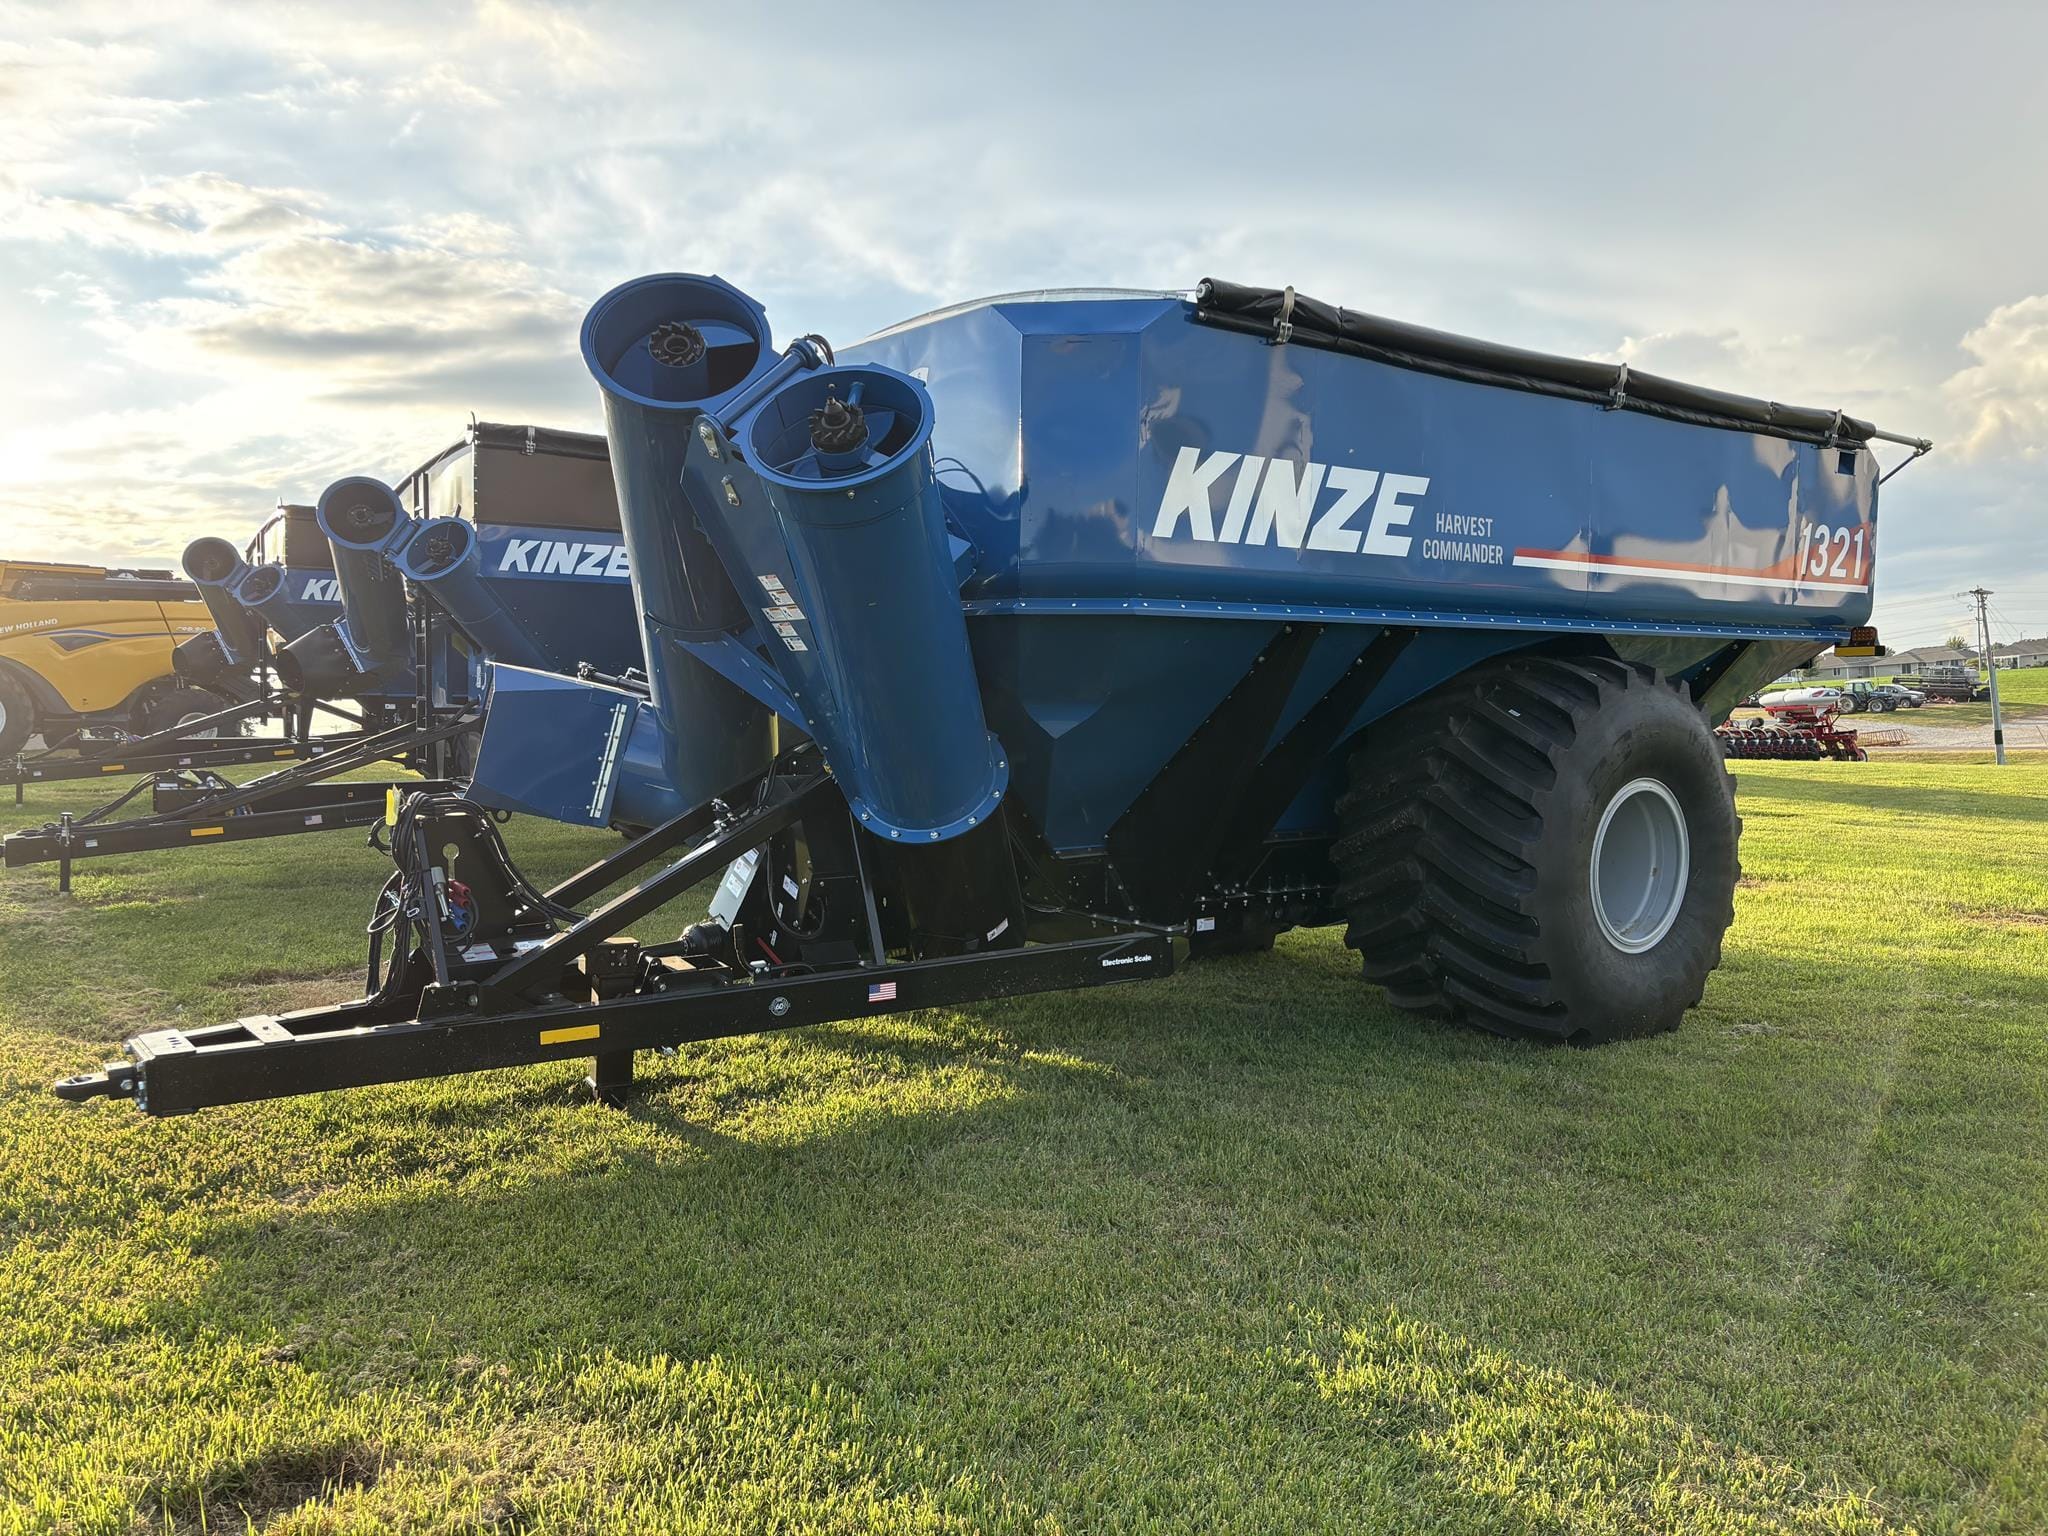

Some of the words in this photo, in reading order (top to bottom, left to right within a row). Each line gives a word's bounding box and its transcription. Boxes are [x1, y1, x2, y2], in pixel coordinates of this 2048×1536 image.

[1151, 446, 1430, 557] KINZE
[1435, 512, 1493, 538] HARVEST
[498, 538, 631, 578] KINZE
[1423, 538, 1503, 565] COMMANDER
[1801, 522, 1864, 579] 1321
[15, 618, 58, 631] HOLLAND
[1102, 956, 1134, 967] Electronic
[1134, 954, 1152, 963] Scale
